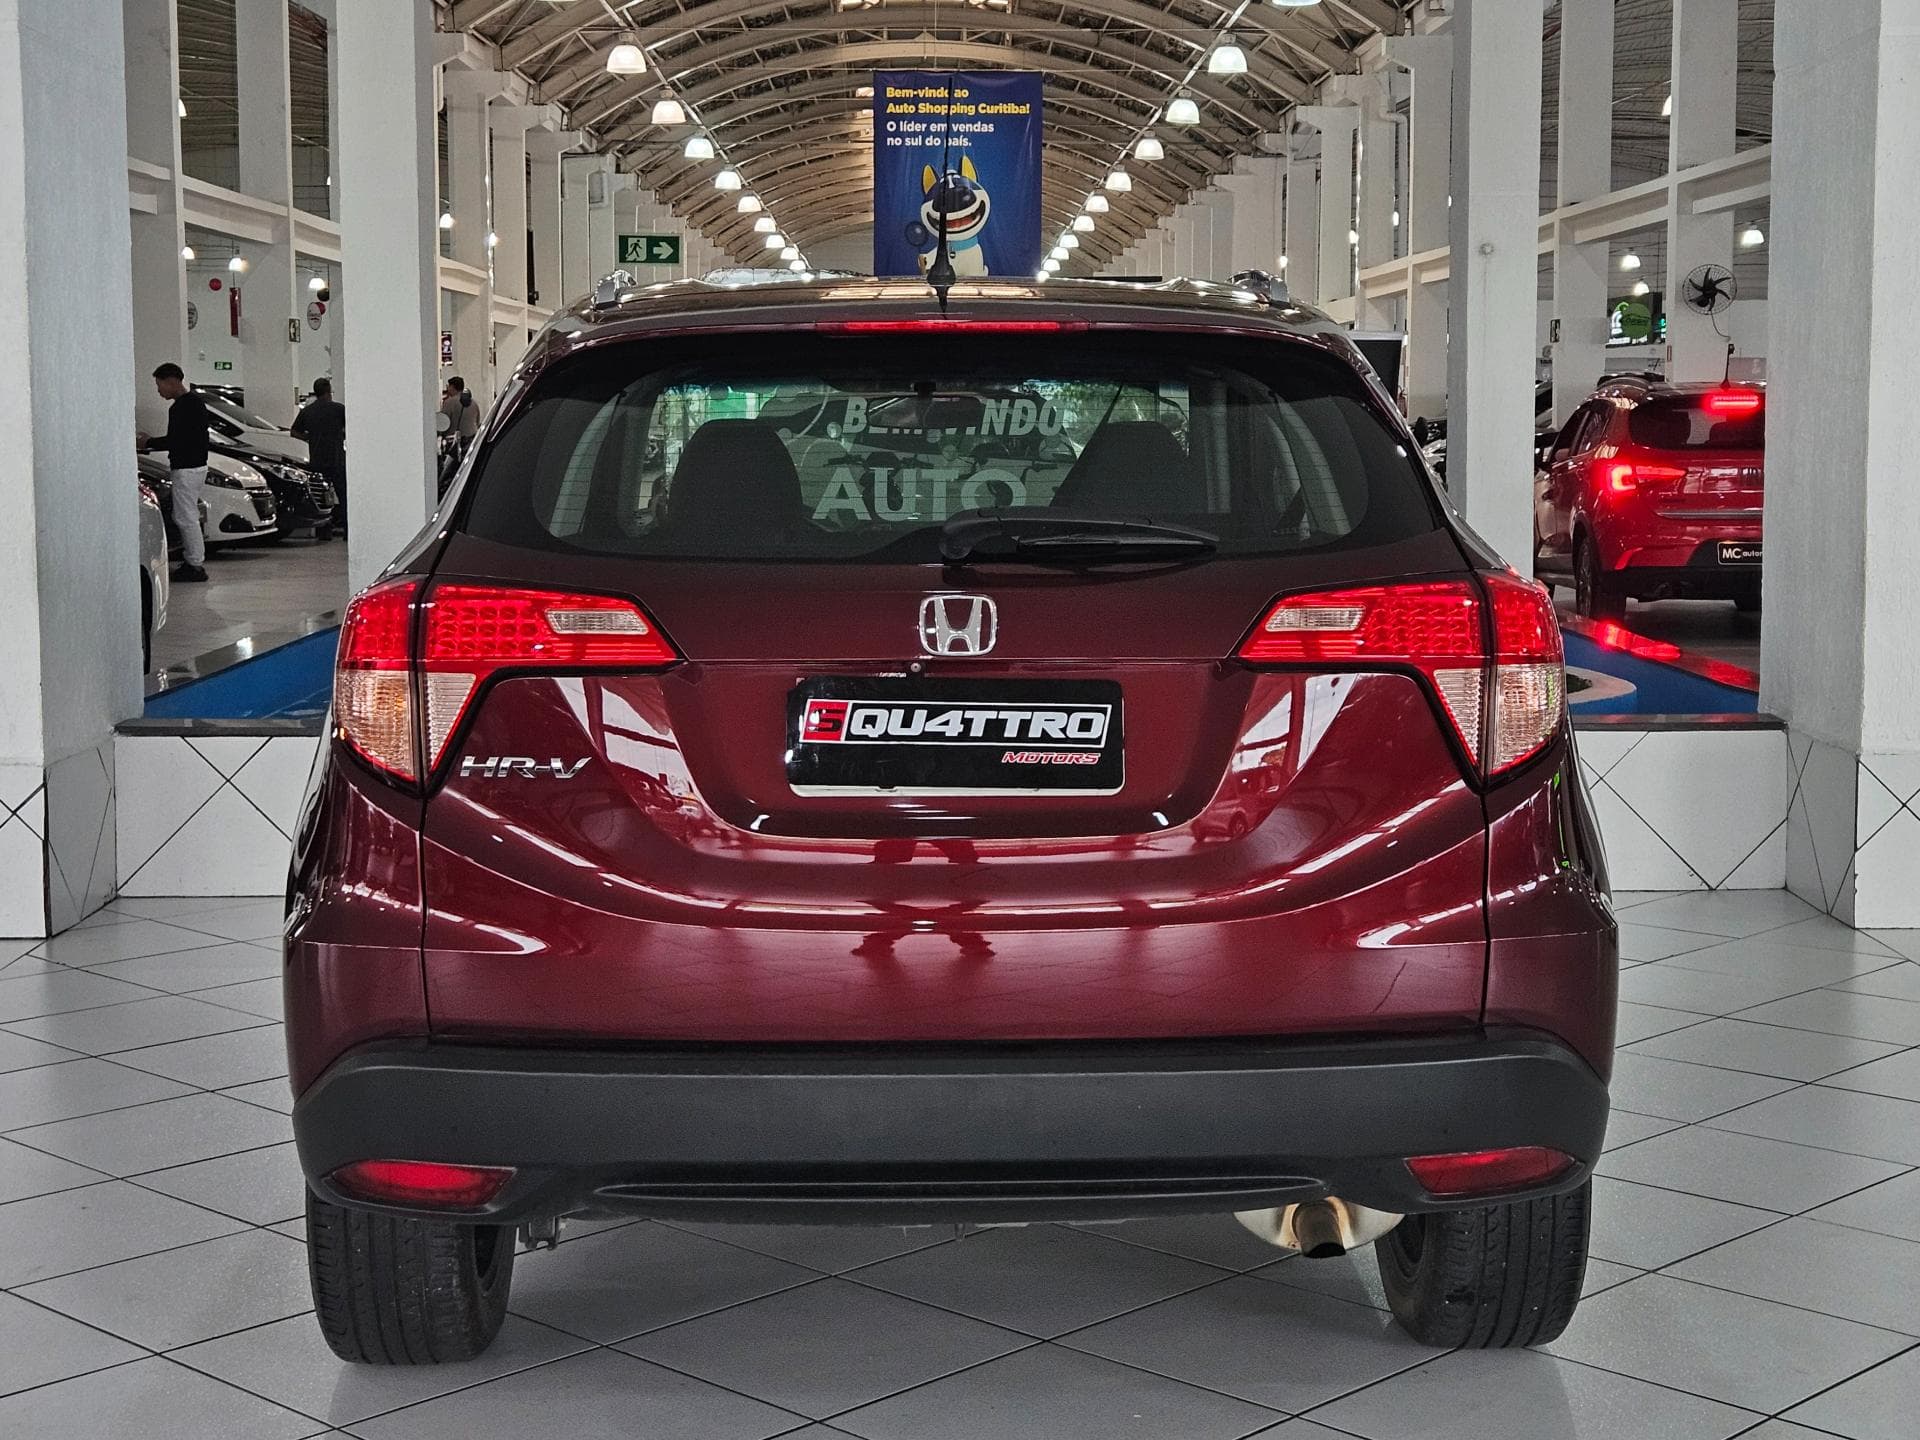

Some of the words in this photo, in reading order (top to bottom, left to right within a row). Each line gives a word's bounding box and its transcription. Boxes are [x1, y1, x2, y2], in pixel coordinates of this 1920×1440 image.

[954, 88, 969, 98] ao
[886, 103, 916, 114] Auto
[918, 103, 976, 115] Shopping
[978, 103, 1030, 114] Curitiba!
[886, 121, 897, 132] O
[900, 120, 927, 132] líder
[930, 123, 948, 132] em
[952, 121, 994, 132] vendas
[887, 136, 902, 146] no
[905, 135, 922, 146] sul
[925, 135, 941, 146] do
[812, 467, 1027, 521] AUTO
[1722, 548, 1742, 559] MC
[850, 708, 1106, 739] QU4TTRO
[1001, 751, 1101, 765] MOTORS
[460, 755, 592, 779] HR-V
